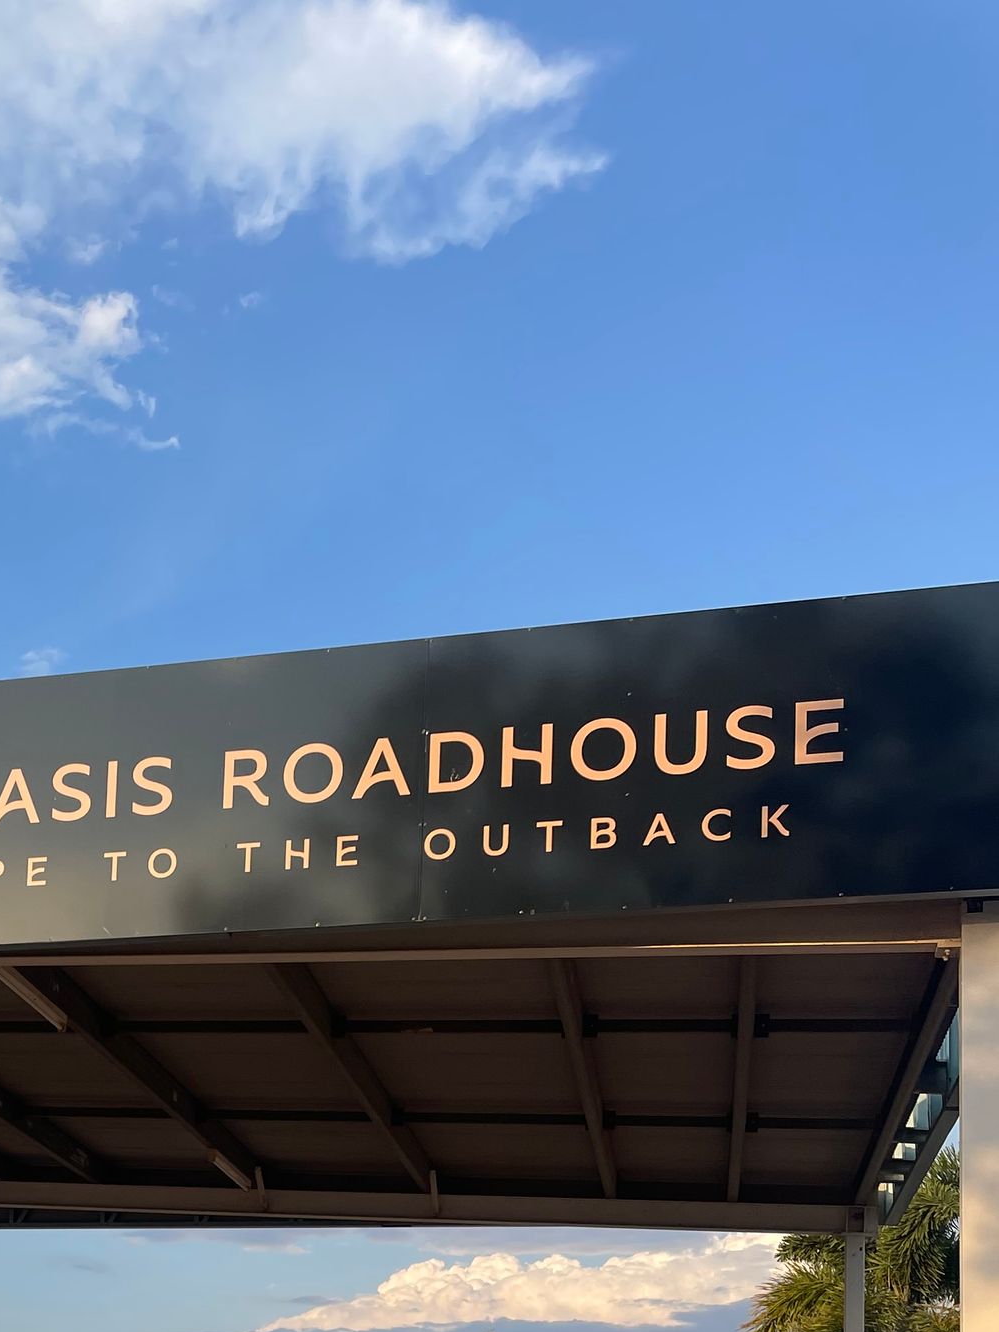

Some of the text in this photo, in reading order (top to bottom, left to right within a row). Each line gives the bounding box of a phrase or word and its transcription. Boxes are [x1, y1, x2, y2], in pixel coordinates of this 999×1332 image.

[222, 698, 844, 809] ROADHOUSE
[104, 848, 177, 882] TO
[236, 835, 359, 873] THE
[423, 804, 790, 860] OUTBACK
